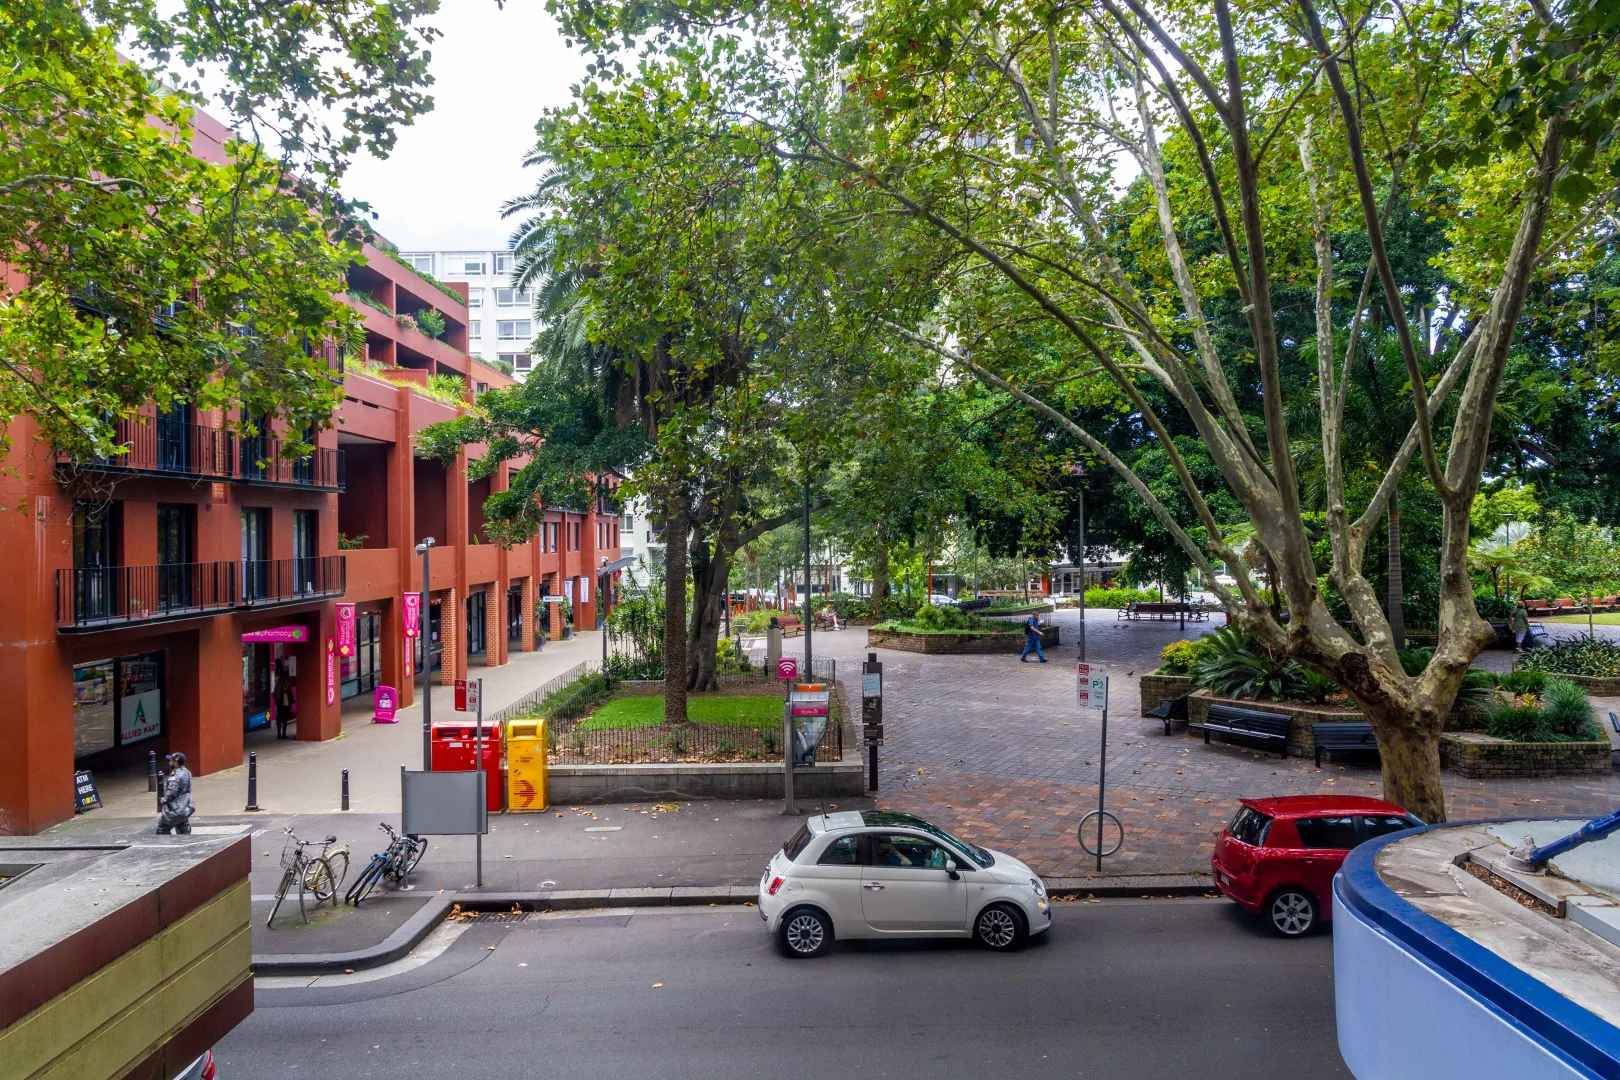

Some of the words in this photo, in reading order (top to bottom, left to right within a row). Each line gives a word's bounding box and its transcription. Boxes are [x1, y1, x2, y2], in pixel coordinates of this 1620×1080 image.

[260, 629, 292, 638] pharmacy
[121, 727, 142, 740] ALLIED
[143, 723, 159, 734] MART
[76, 774, 89, 784] ATM
[78, 783, 94, 794] HERE
